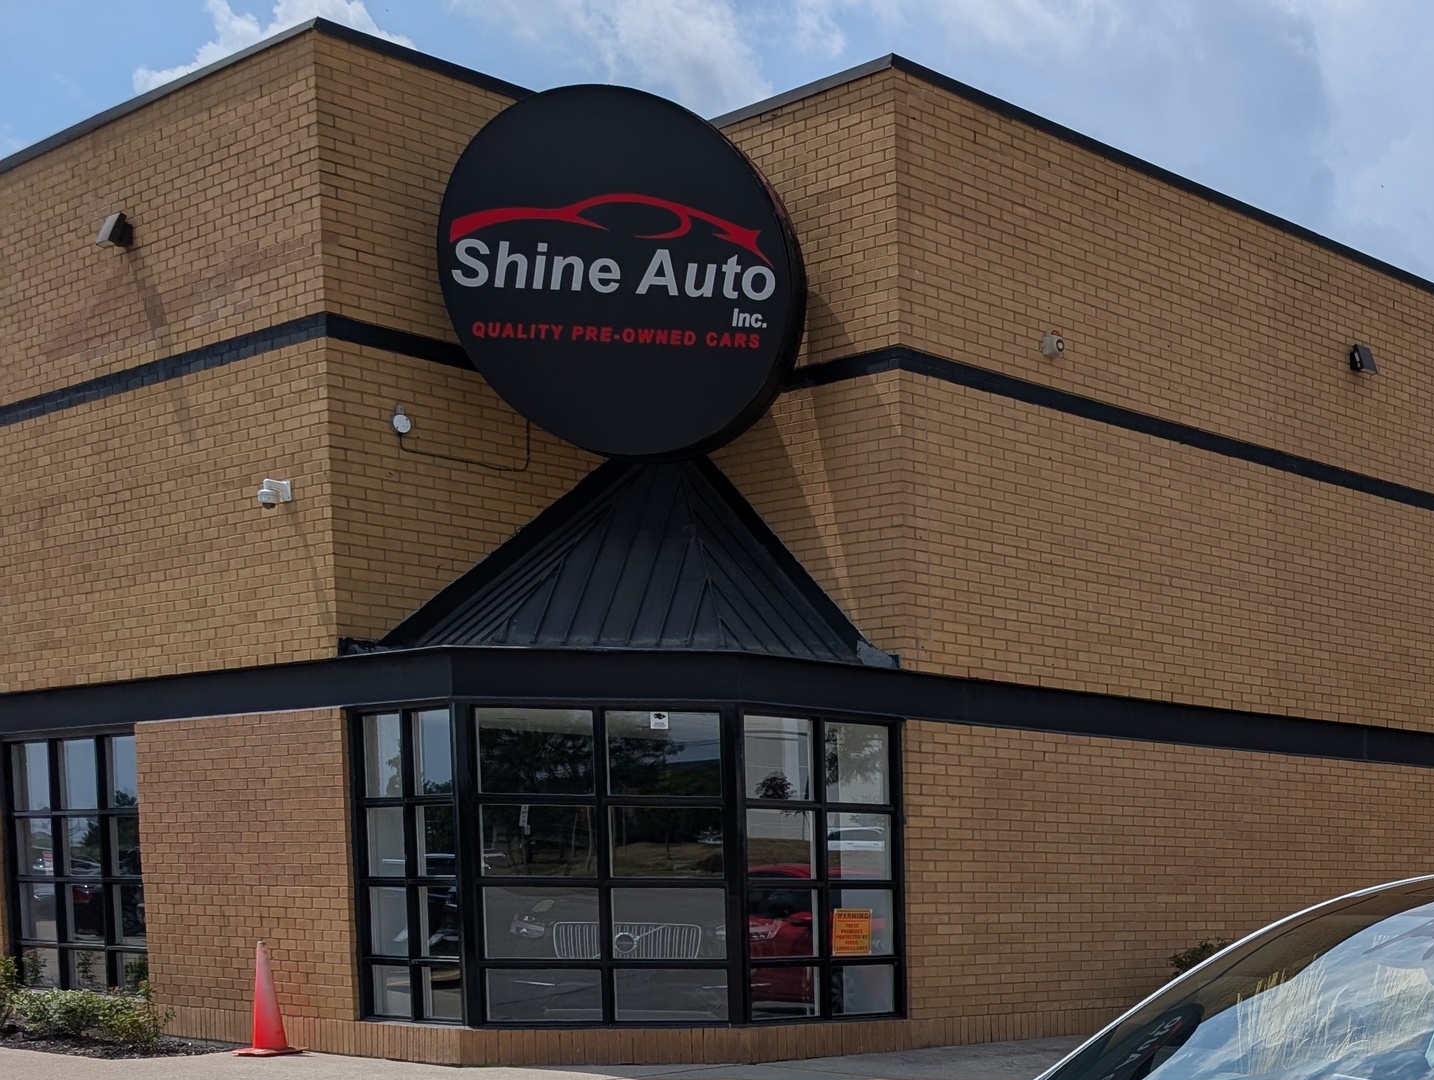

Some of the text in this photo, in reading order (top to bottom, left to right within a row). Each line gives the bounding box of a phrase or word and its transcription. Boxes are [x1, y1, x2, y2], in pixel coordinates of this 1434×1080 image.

[451, 238, 776, 301] Shine Auto
[731, 307, 768, 329] Inc.
[471, 320, 761, 349] QUALITY PRE-OWNED CARS
[837, 912, 869, 920] WARNING
